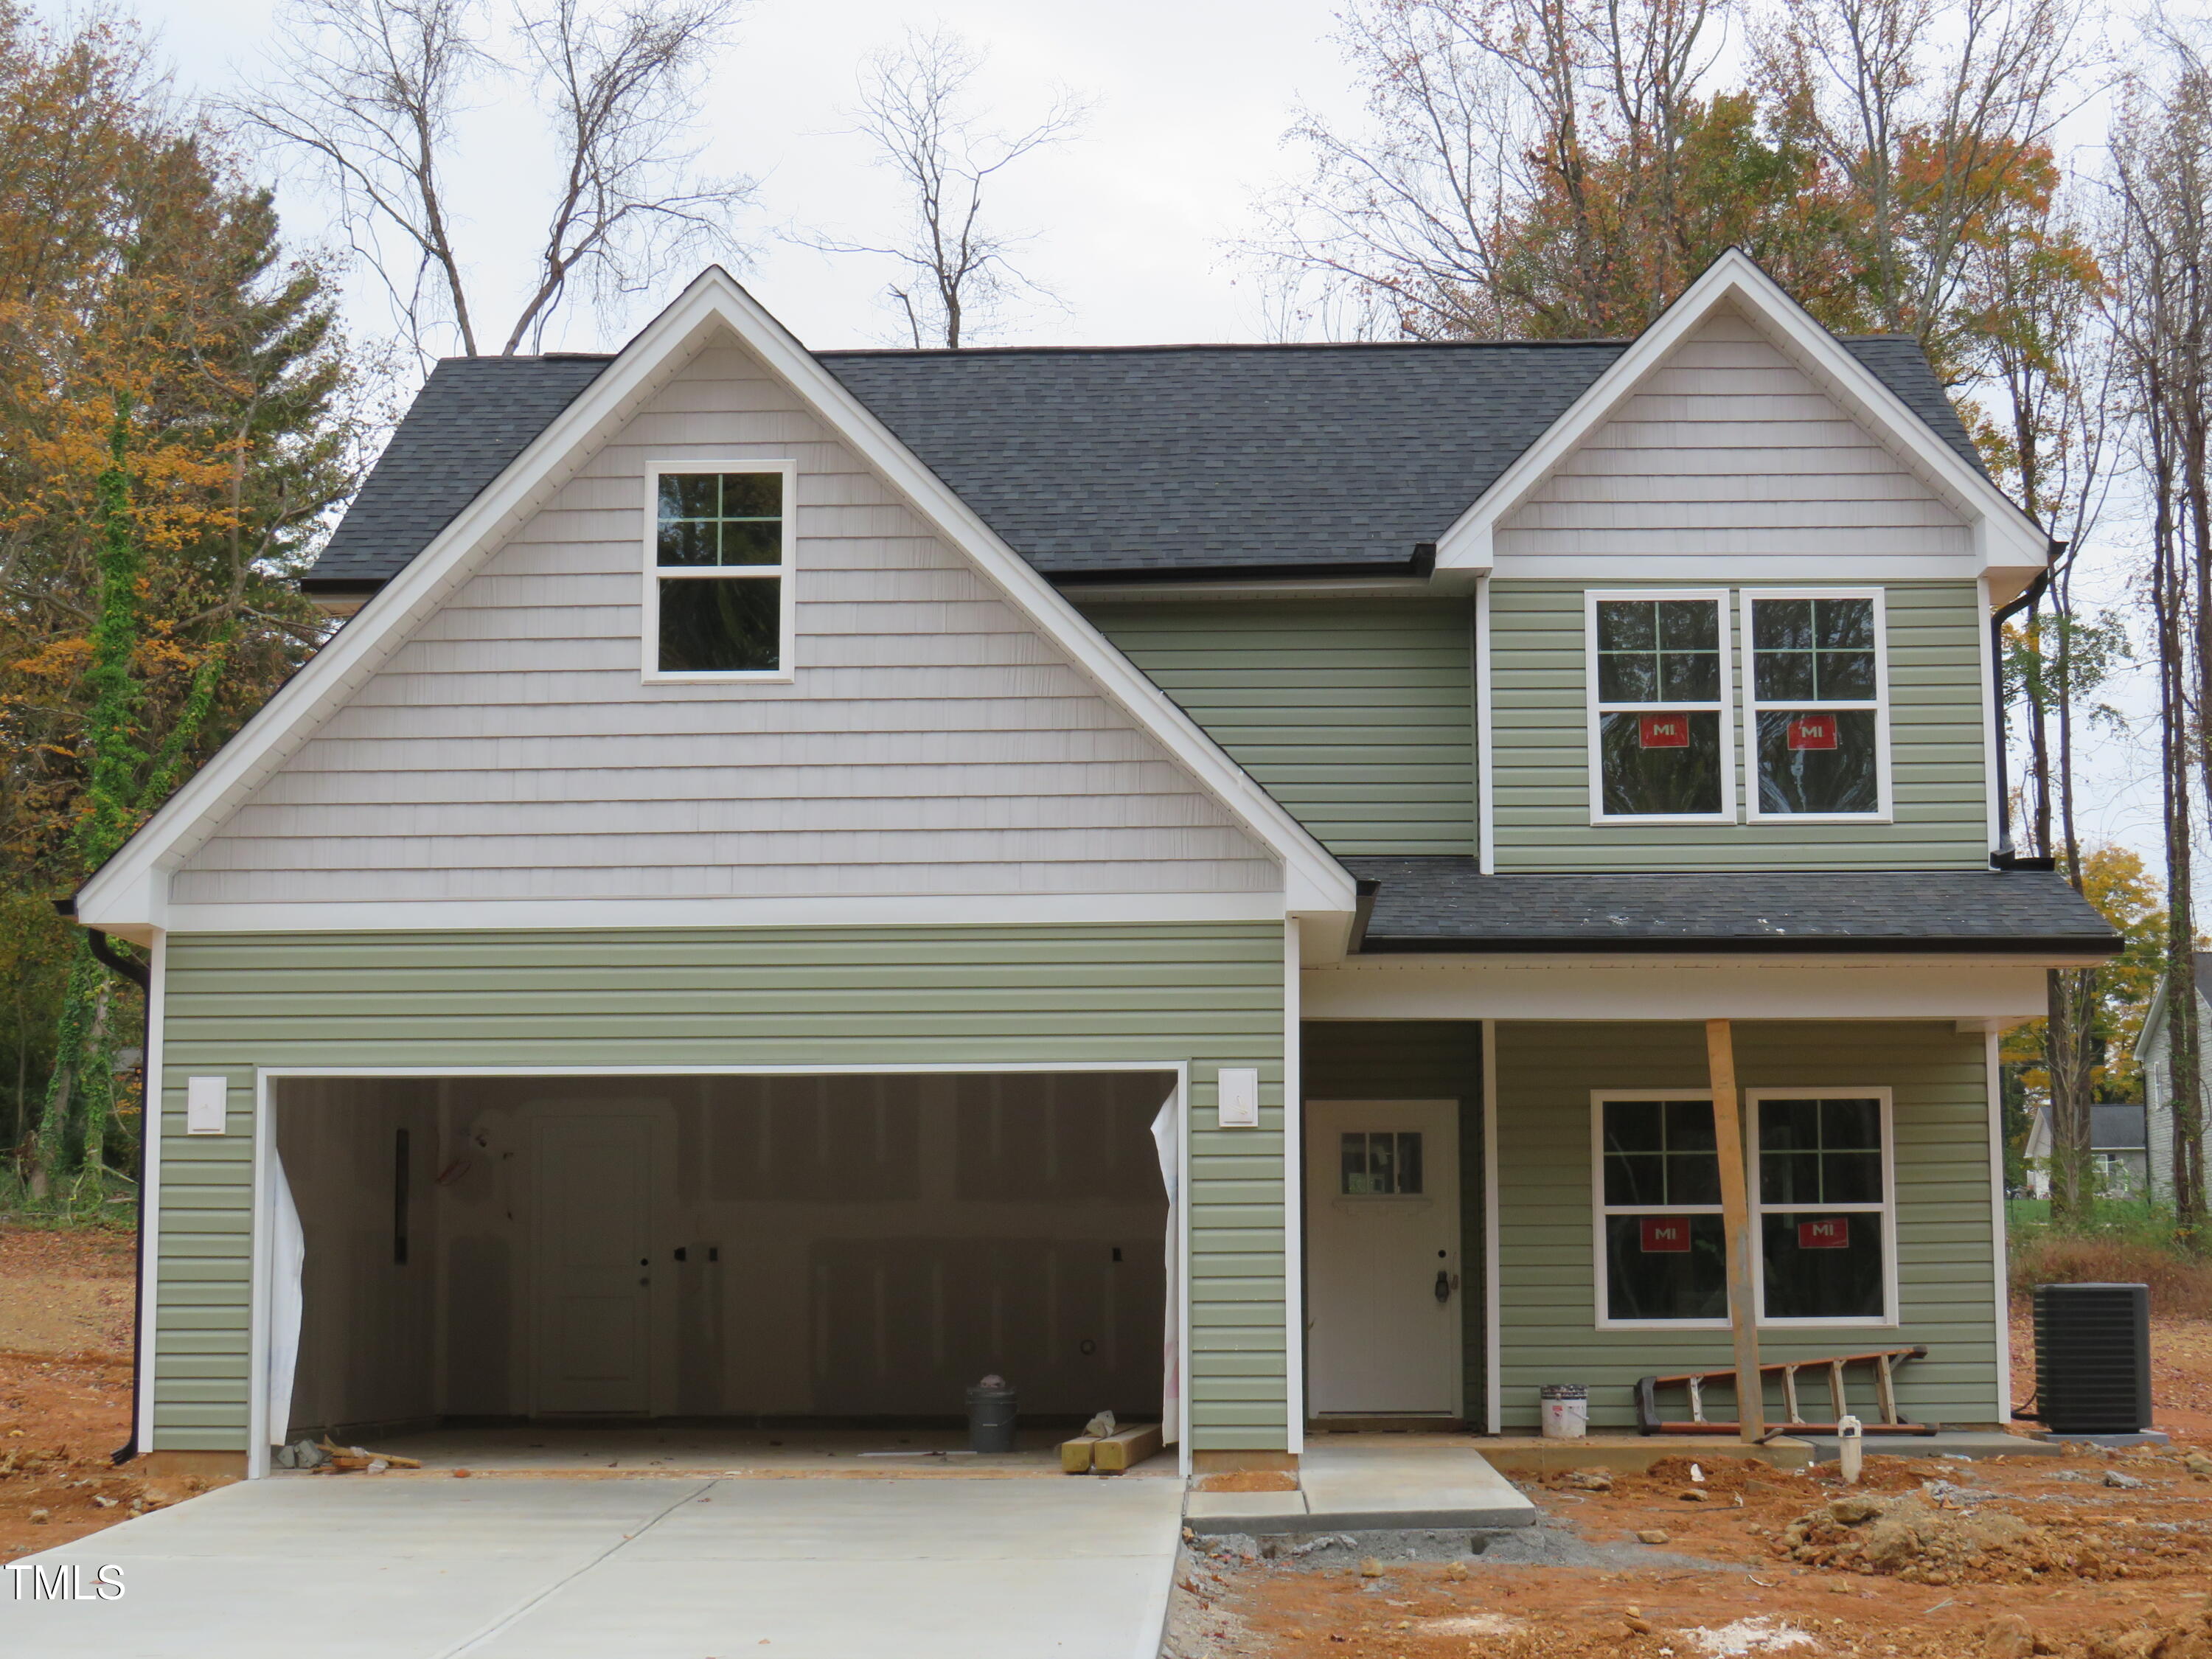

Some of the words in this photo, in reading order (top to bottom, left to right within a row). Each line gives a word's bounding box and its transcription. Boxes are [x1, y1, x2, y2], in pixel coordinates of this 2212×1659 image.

[1654, 725, 1674, 736] MI
[1801, 726, 1823, 738] MI
[1655, 1228, 1676, 1239] MI
[1813, 1224, 1834, 1236] MI
